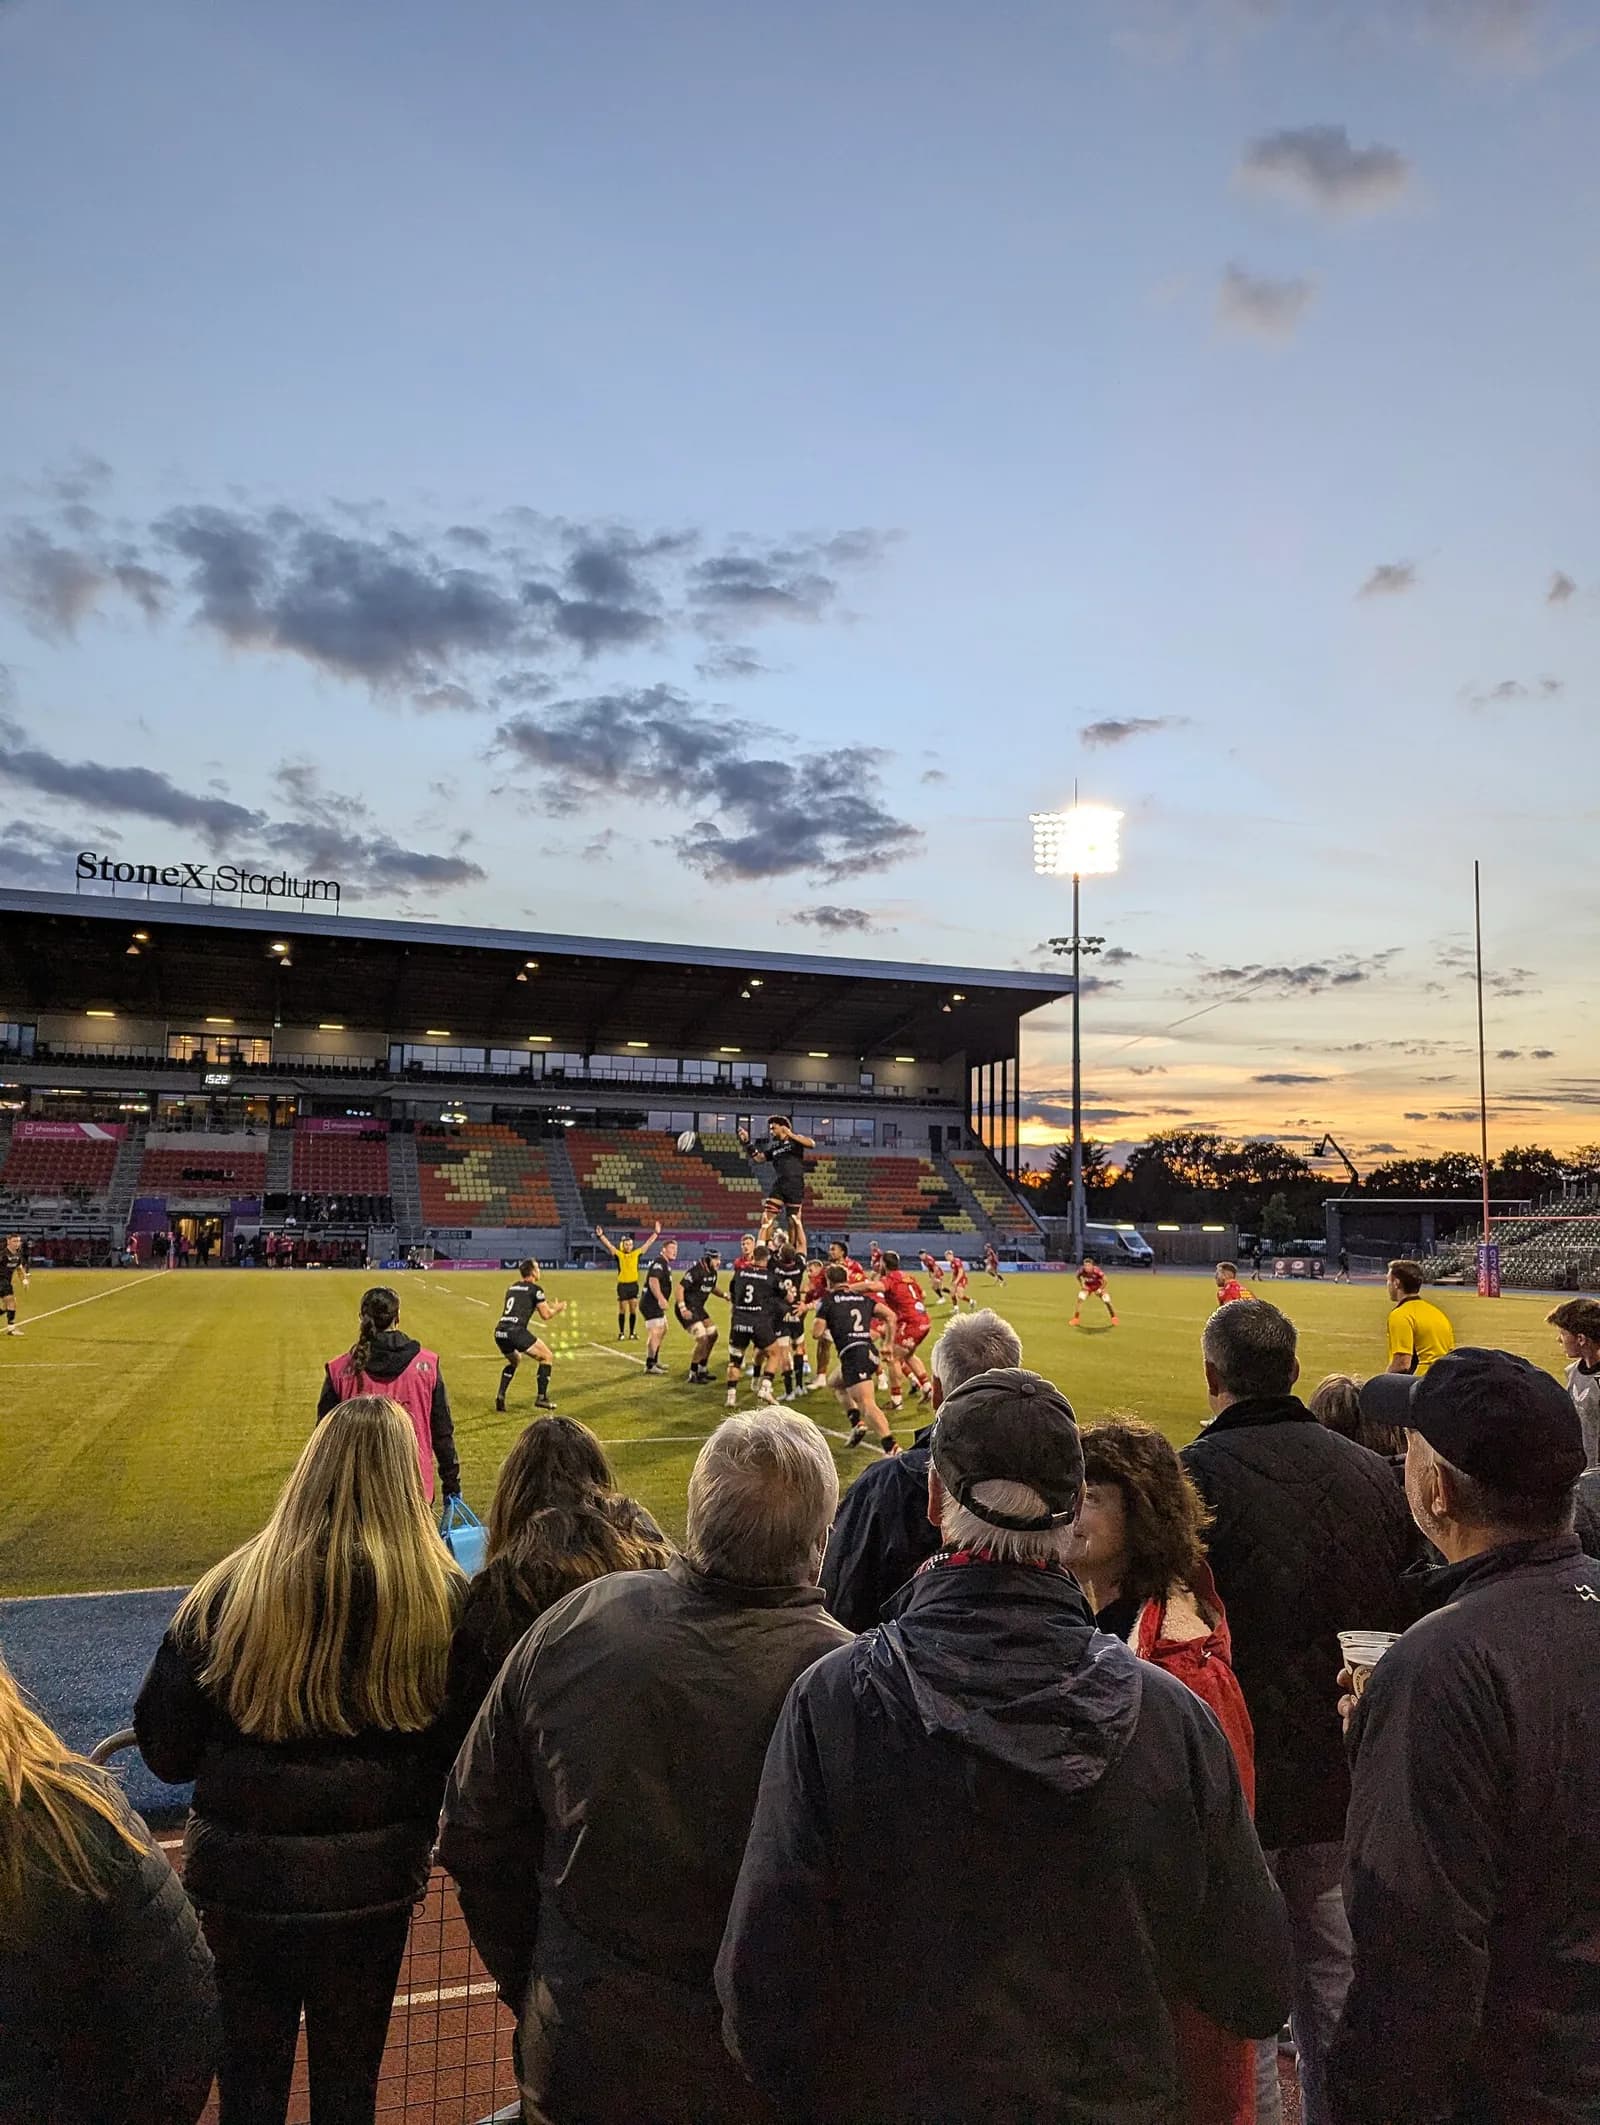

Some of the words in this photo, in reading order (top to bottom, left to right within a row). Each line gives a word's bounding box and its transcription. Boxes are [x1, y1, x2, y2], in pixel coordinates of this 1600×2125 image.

[76, 851, 208, 889] StoneX
[215, 865, 341, 900] Stadium
[744, 1285, 755, 1304] 3
[504, 1296, 515, 1315] 9
[850, 1308, 864, 1332] 2
